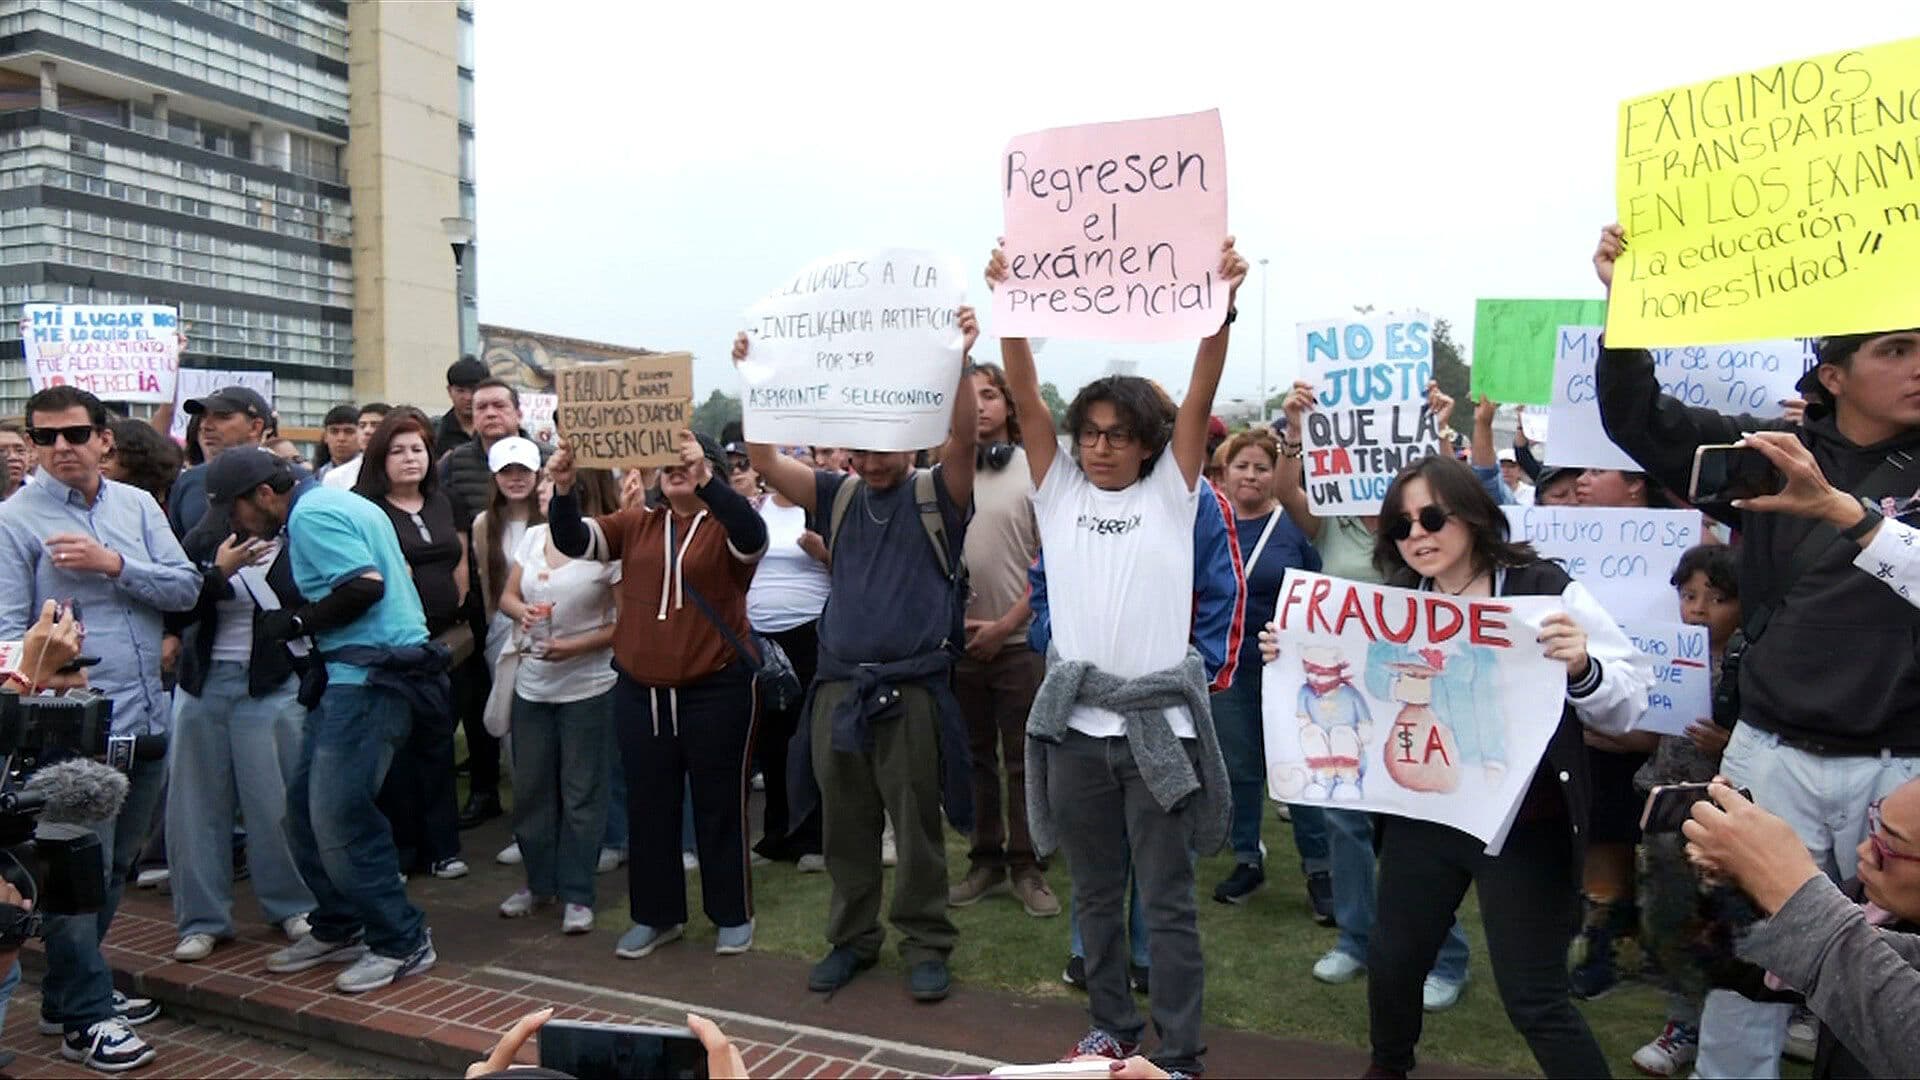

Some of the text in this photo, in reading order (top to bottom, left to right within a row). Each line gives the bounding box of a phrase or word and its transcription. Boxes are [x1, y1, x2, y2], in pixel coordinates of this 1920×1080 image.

[1625, 51, 1872, 158] EXIGIMOS
[1007, 150, 1208, 213] Regresen
[1629, 138, 1920, 238] EN LOS EXAM
[1083, 203, 1117, 242] el
[1631, 248, 1668, 282] La
[1677, 206, 1857, 270] educación
[883, 261, 896, 288] A
[912, 263, 938, 289] LA
[1011, 244, 1178, 280] exámen
[33, 327, 65, 343] ME
[74, 312, 144, 328] LUGAR
[760, 307, 873, 342] INTELIGENCIA
[1306, 322, 1430, 363] NO ES
[564, 368, 630, 402] FRAUDE
[749, 384, 830, 408] ASPIRANTE
[1319, 361, 1431, 408] JUSTO
[1726, 380, 1768, 408] no
[564, 404, 634, 430] EXIGIMOS
[638, 400, 683, 425] EXAMEN
[1308, 404, 1439, 448] QUE LA
[570, 429, 681, 460] PRESENCIAL
[1308, 447, 1352, 477] IA
[1311, 480, 1343, 506] UN
[1620, 519, 1656, 543] no
[1280, 579, 1513, 648] FRAUDE
[1677, 632, 1704, 658] NO
